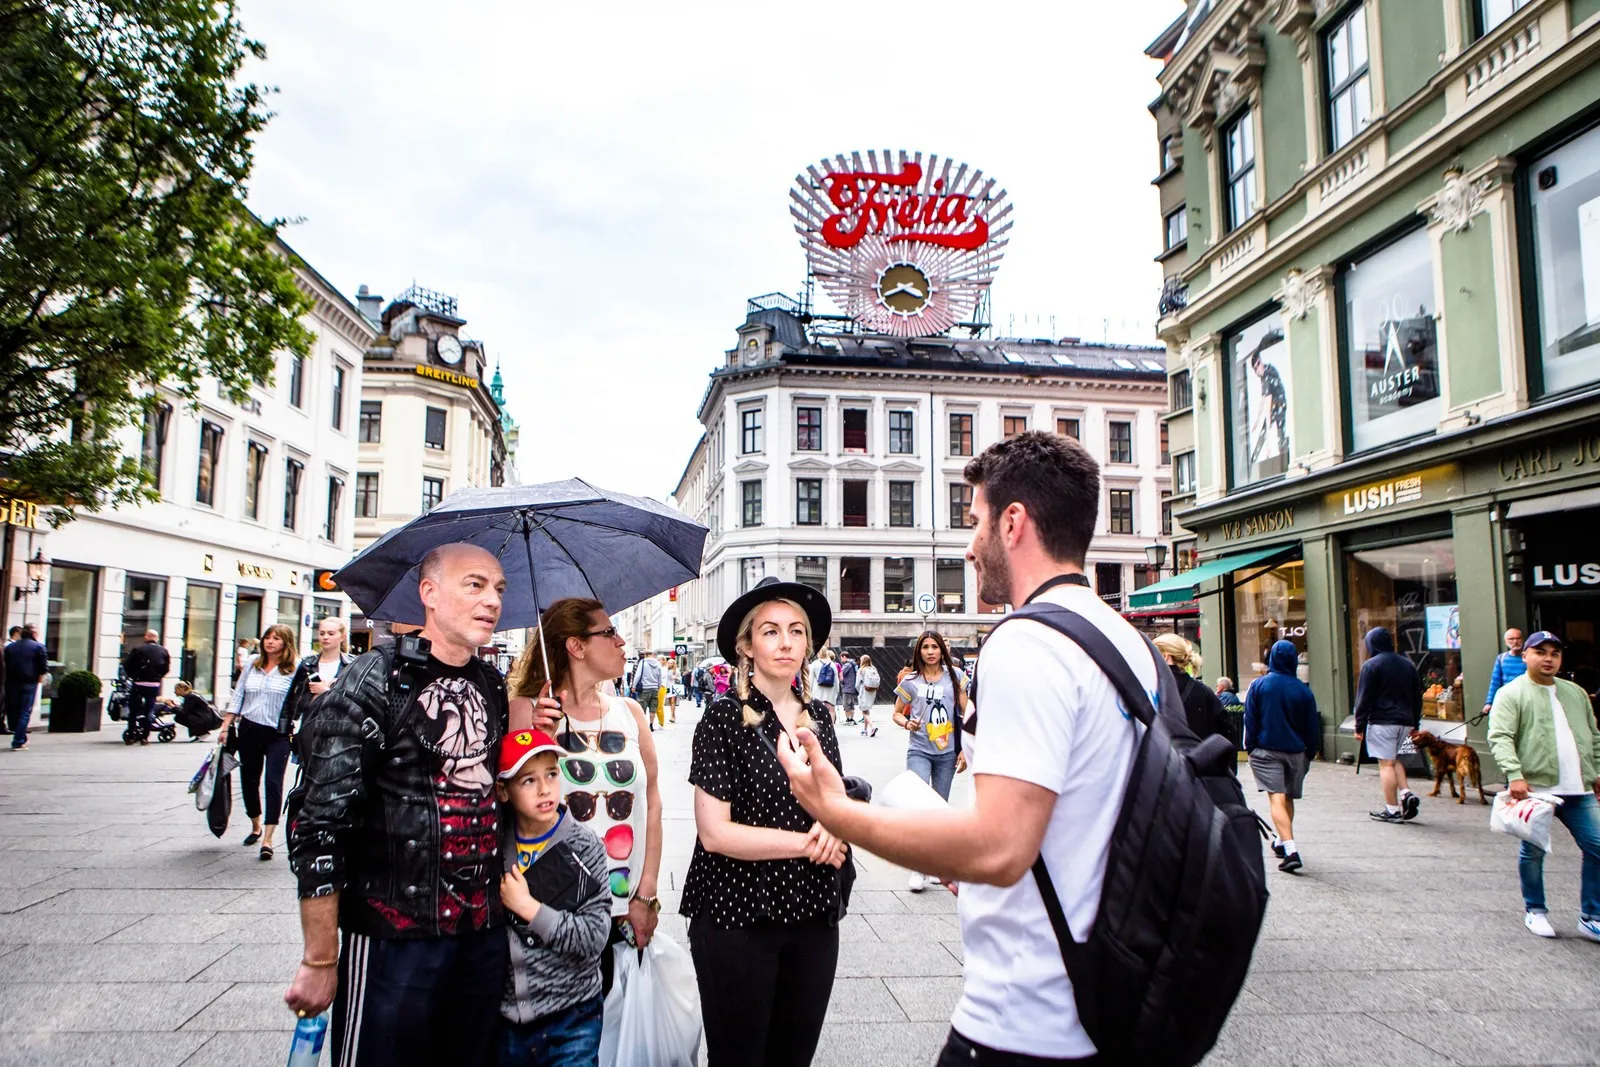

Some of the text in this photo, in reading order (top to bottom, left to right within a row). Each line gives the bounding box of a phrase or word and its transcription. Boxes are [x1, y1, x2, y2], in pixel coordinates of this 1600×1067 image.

[820, 162, 990, 251] Freia
[416, 364, 478, 389] BREITLING
[1370, 365, 1420, 399] AUSTER
[1497, 444, 1562, 481] CARL
[1344, 482, 1395, 515] LUSH
[1245, 507, 1294, 537] SAMSON
[1533, 562, 1600, 587] LUS
